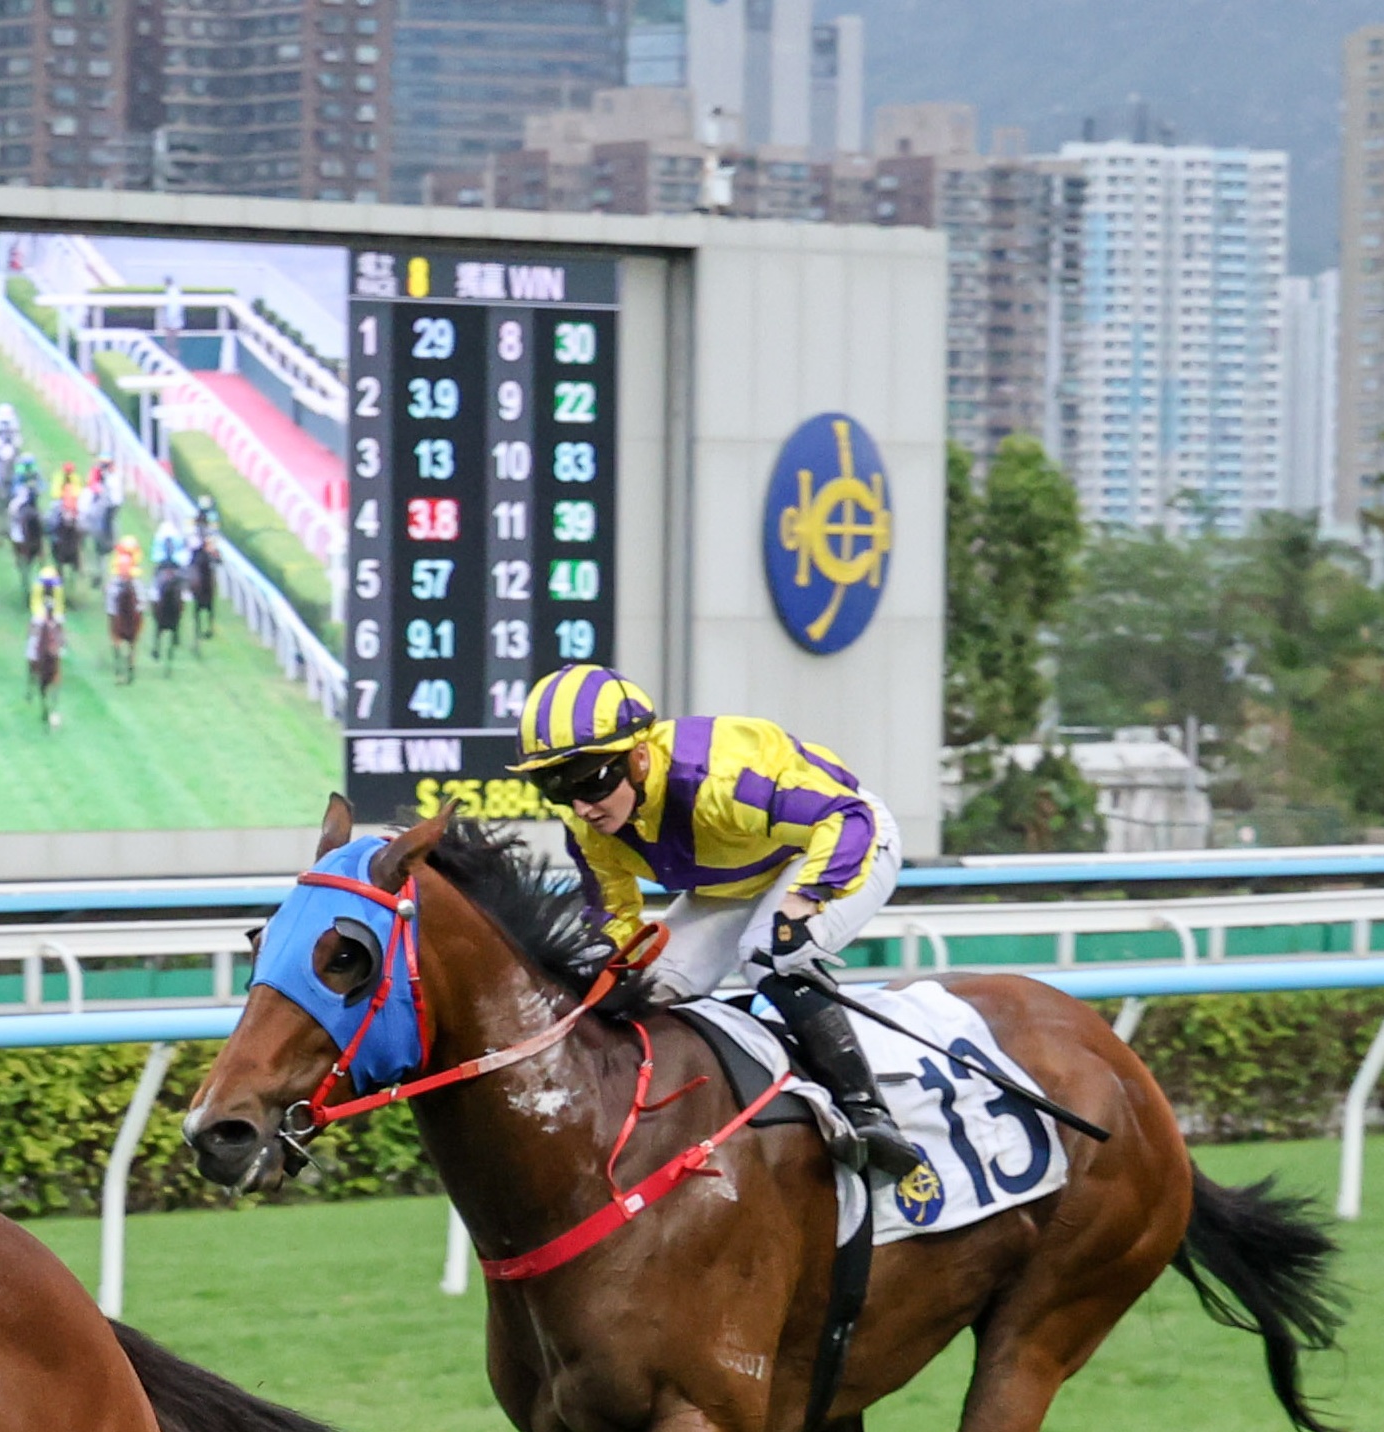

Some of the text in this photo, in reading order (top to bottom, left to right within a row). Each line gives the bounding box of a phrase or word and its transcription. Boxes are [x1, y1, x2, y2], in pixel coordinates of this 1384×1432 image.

[508, 265, 565, 301] WIN
[359, 317, 378, 355] 1
[412, 318, 456, 359] 29
[498, 321, 522, 361] 8
[555, 323, 596, 363] 30
[356, 377, 380, 417] 2
[498, 381, 522, 421] 9
[554, 382, 595, 423] 22
[356, 438, 381, 478] 3
[413, 440, 454, 479] 13
[492, 441, 530, 480] 10
[554, 442, 595, 481] 83
[355, 499, 380, 537] 4
[493, 502, 526, 540] 11
[554, 501, 595, 541] 39
[356, 559, 381, 599] 5
[412, 560, 454, 600] 57
[491, 560, 530, 600] 12
[548, 560, 598, 600] 4.0
[355, 619, 380, 659] 6
[407, 620, 454, 660] 9.1
[491, 620, 529, 659] 13
[555, 620, 594, 659] 19
[355, 680, 379, 718] 7
[408, 680, 453, 719] 40
[490, 680, 525, 719] 14
[404, 739, 462, 773] WIN
[916, 1036, 1051, 1209] 13
